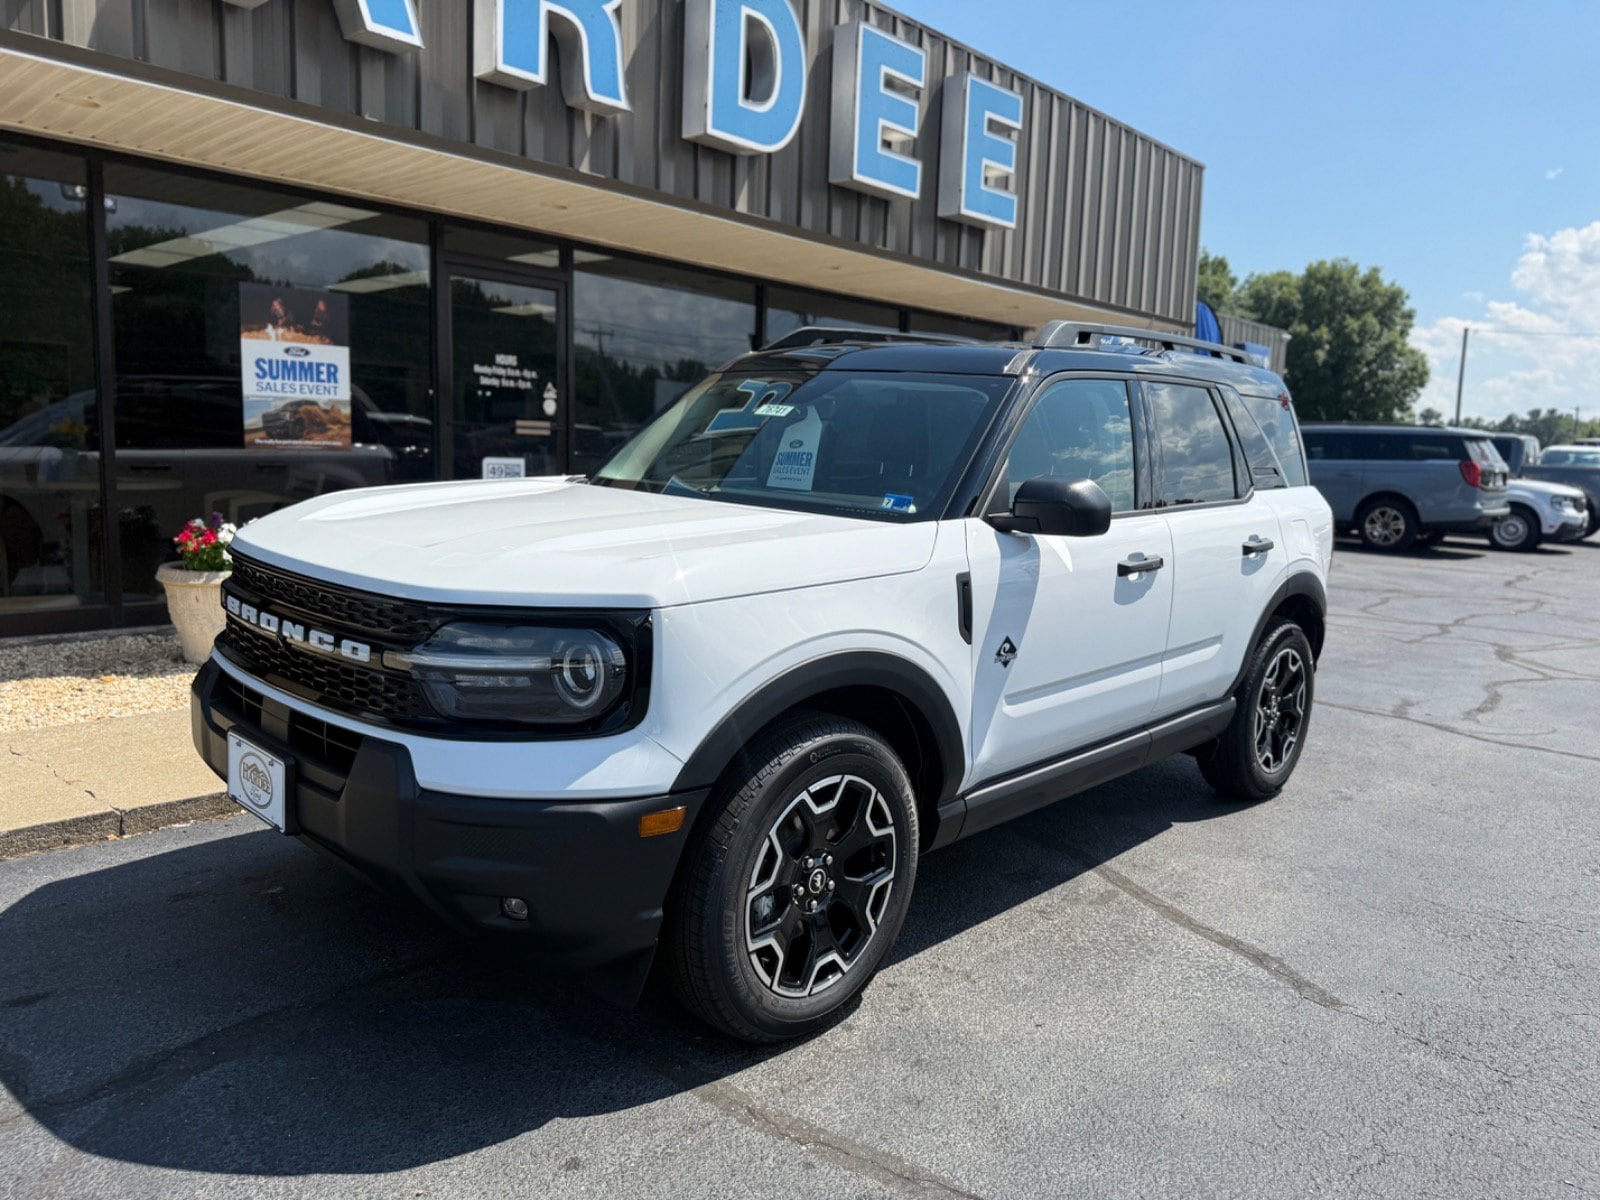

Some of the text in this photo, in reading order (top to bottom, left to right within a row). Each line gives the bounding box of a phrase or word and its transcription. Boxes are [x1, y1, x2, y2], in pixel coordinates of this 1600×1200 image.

[255, 357, 339, 384] SUMMER
[256, 381, 339, 396] SALES EVENT
[776, 451, 813, 467] SUMMER
[226, 594, 371, 663] BRONCO
